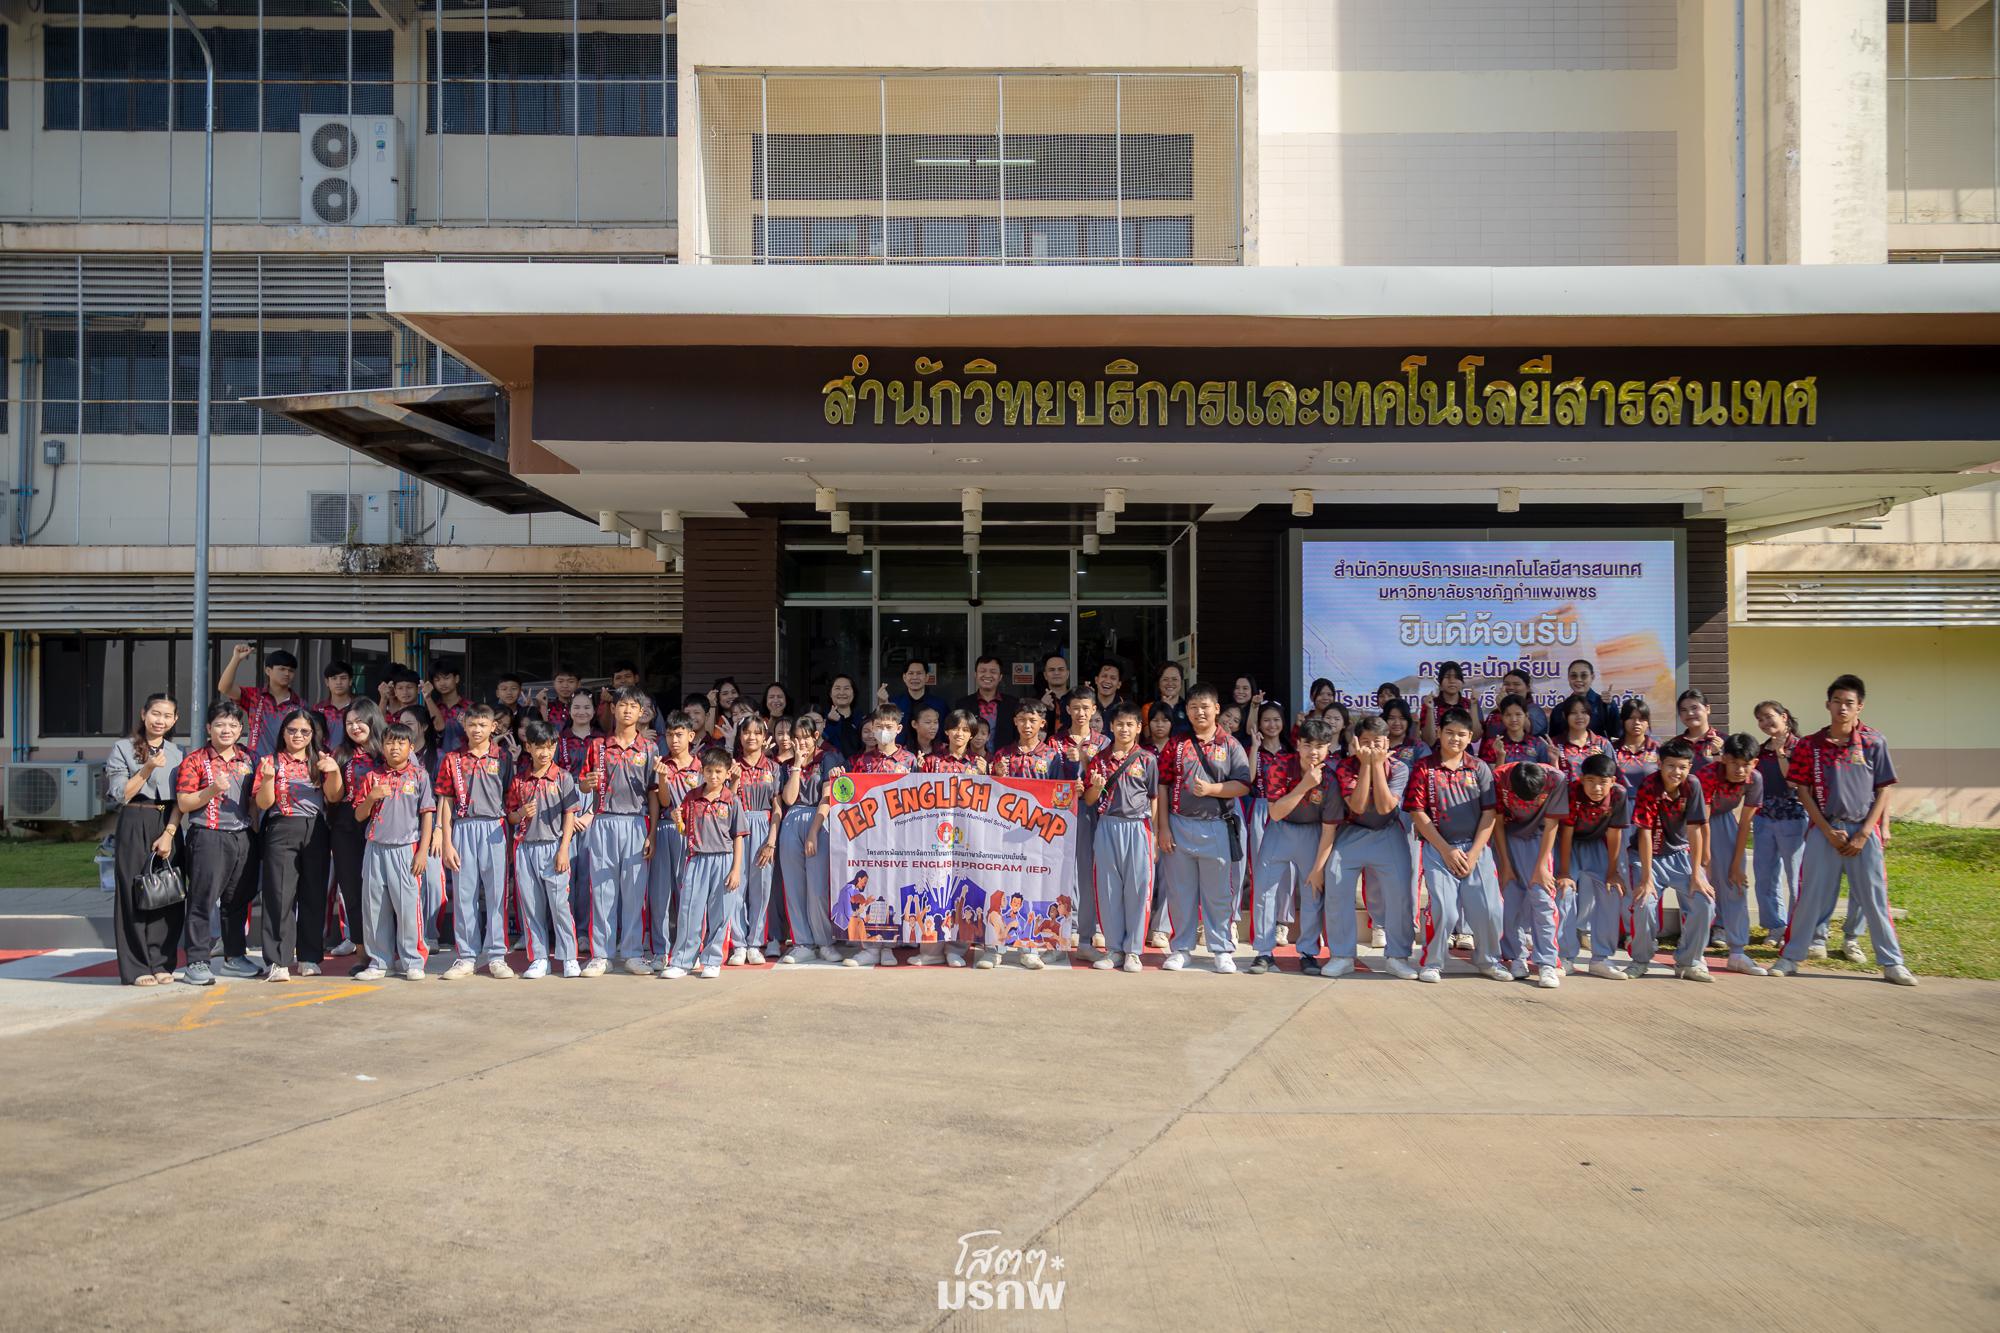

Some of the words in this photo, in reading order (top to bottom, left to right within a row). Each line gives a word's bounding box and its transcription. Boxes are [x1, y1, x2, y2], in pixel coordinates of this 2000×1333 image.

[821, 354, 1818, 427] สำนักวิทยบริการและเทคโนโลยีสารสนเทศ
[1334, 559, 1643, 578] สำนักวิทยบริการและเทคโนโลยีสารสนเทศ
[1379, 584, 1597, 602] มหาวิทยาลัยราชภัฏกำแพงเพชร
[1400, 611, 1579, 645] ยินดีต้อนรับ
[993, 820, 1012, 831] School
[996, 792, 1068, 844] CAMP
[848, 859, 908, 868] INTENSIVE
[912, 860, 960, 869] ENGLISH
[961, 861, 1023, 872] PROGRAM
[1025, 865, 1052, 875] (IEP)
